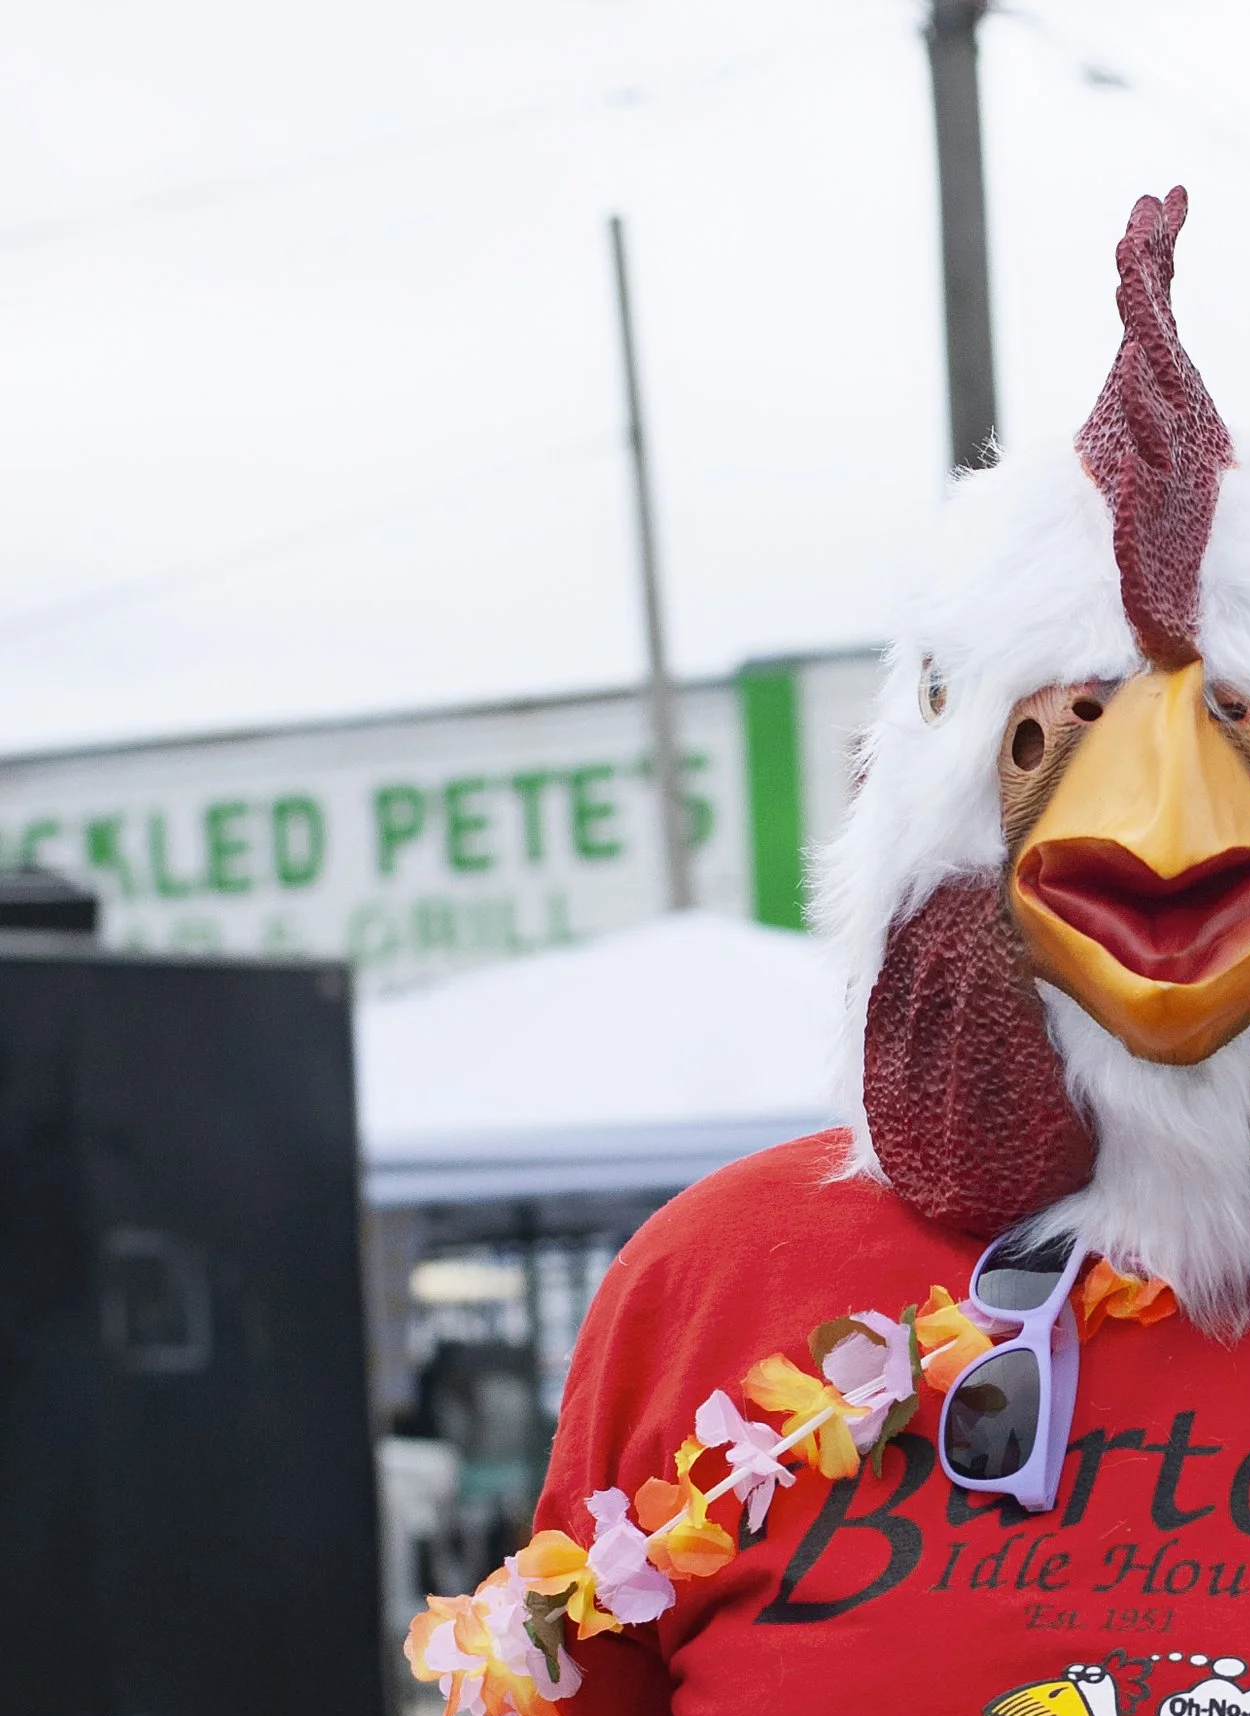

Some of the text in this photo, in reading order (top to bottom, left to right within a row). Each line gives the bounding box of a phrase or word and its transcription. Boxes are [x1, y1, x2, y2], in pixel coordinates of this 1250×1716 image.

[0, 797, 326, 902] CKLED
[928, 1532, 1070, 1592] Idle
[1024, 1603, 1175, 1633] Est. 1951
